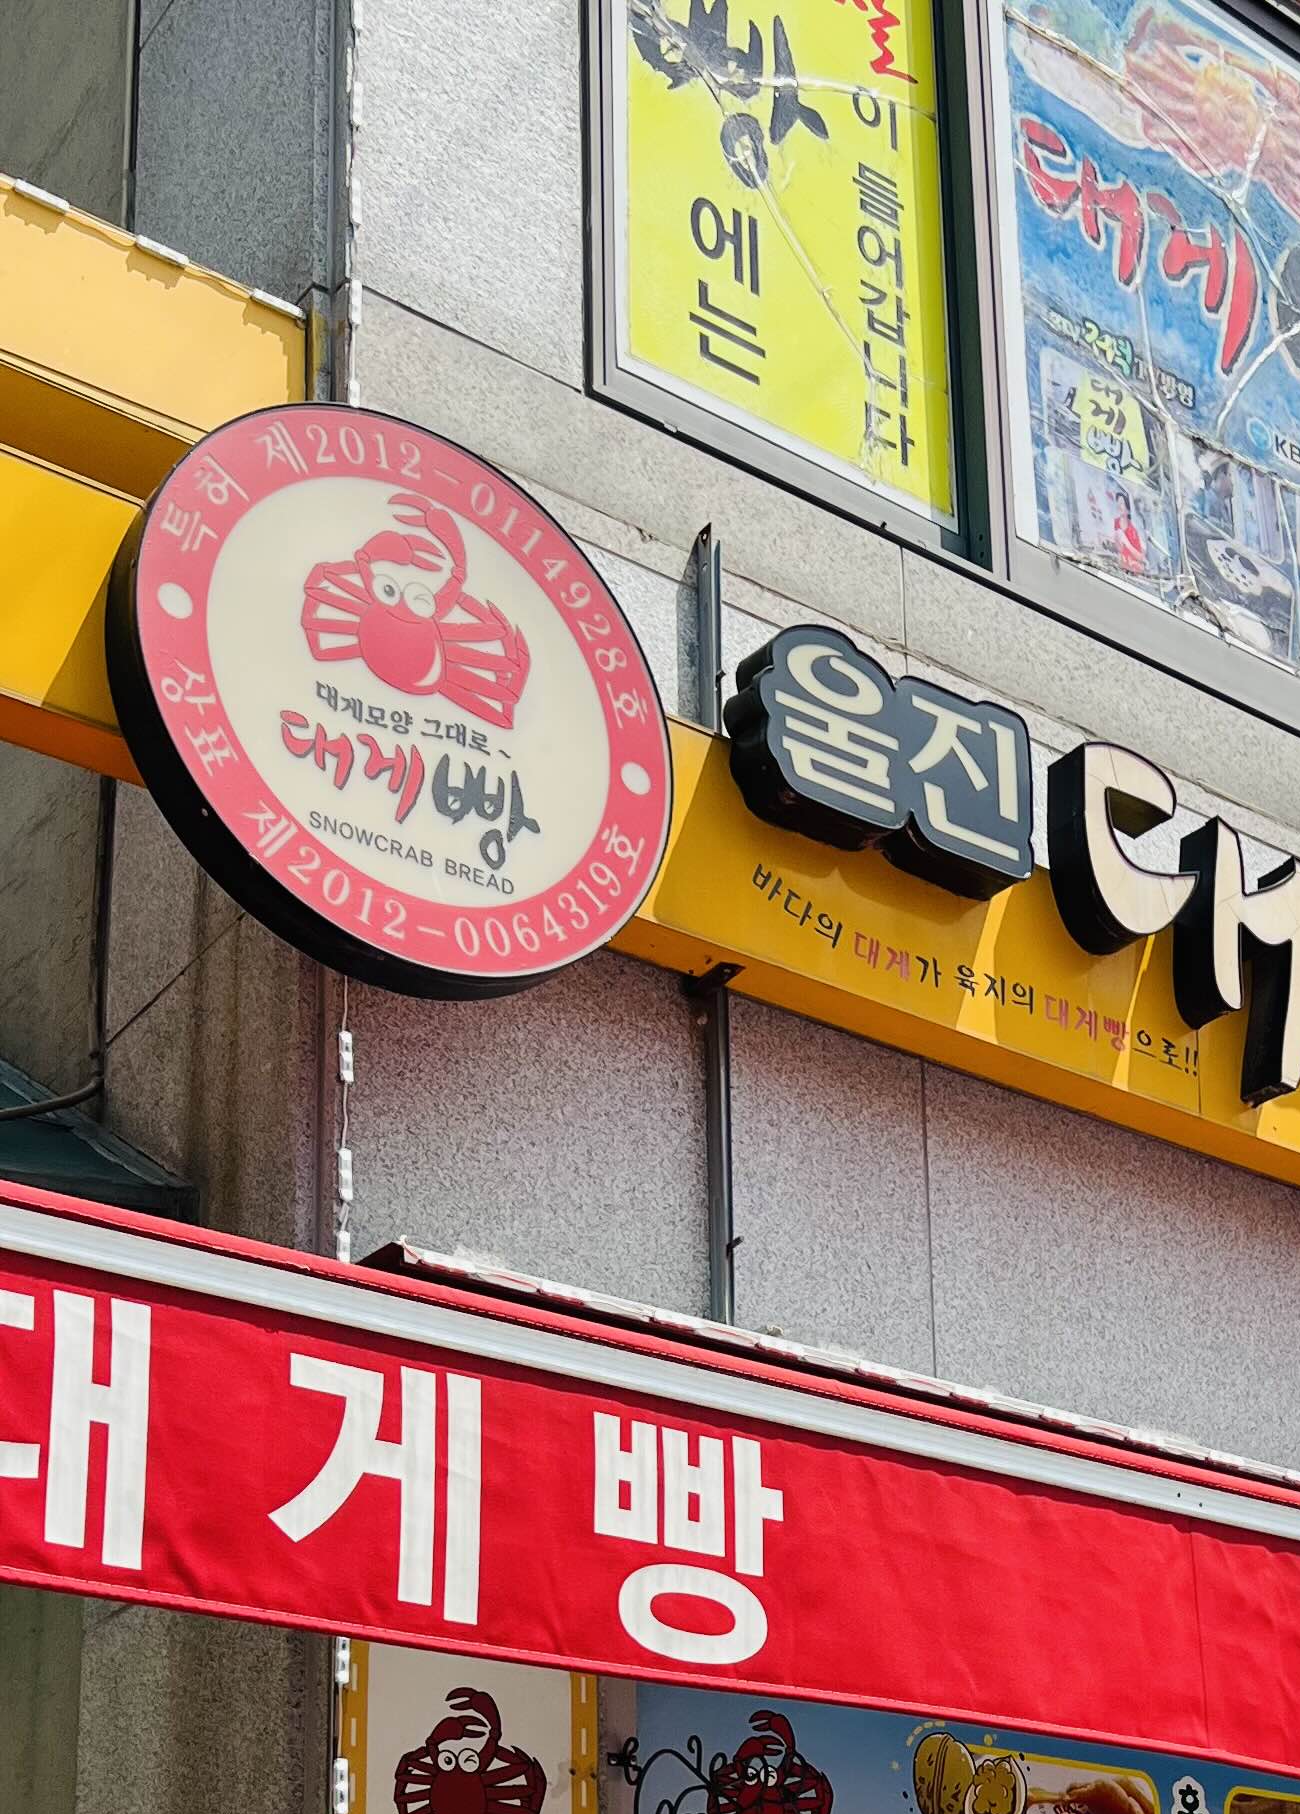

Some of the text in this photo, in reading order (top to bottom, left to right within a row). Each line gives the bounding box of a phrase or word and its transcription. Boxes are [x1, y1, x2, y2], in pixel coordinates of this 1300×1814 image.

[162, 454, 250, 553] 특허
[161, 657, 238, 777] 상표
[315, 681, 413, 736] 대게모양
[775, 643, 1022, 862] 울진
[280, 710, 540, 869] 대게빵
[309, 811, 515, 895] SNOWCRAB BREAD
[752, 863, 1199, 1077] 바다의 대게가 육지의 대게빵으로!!
